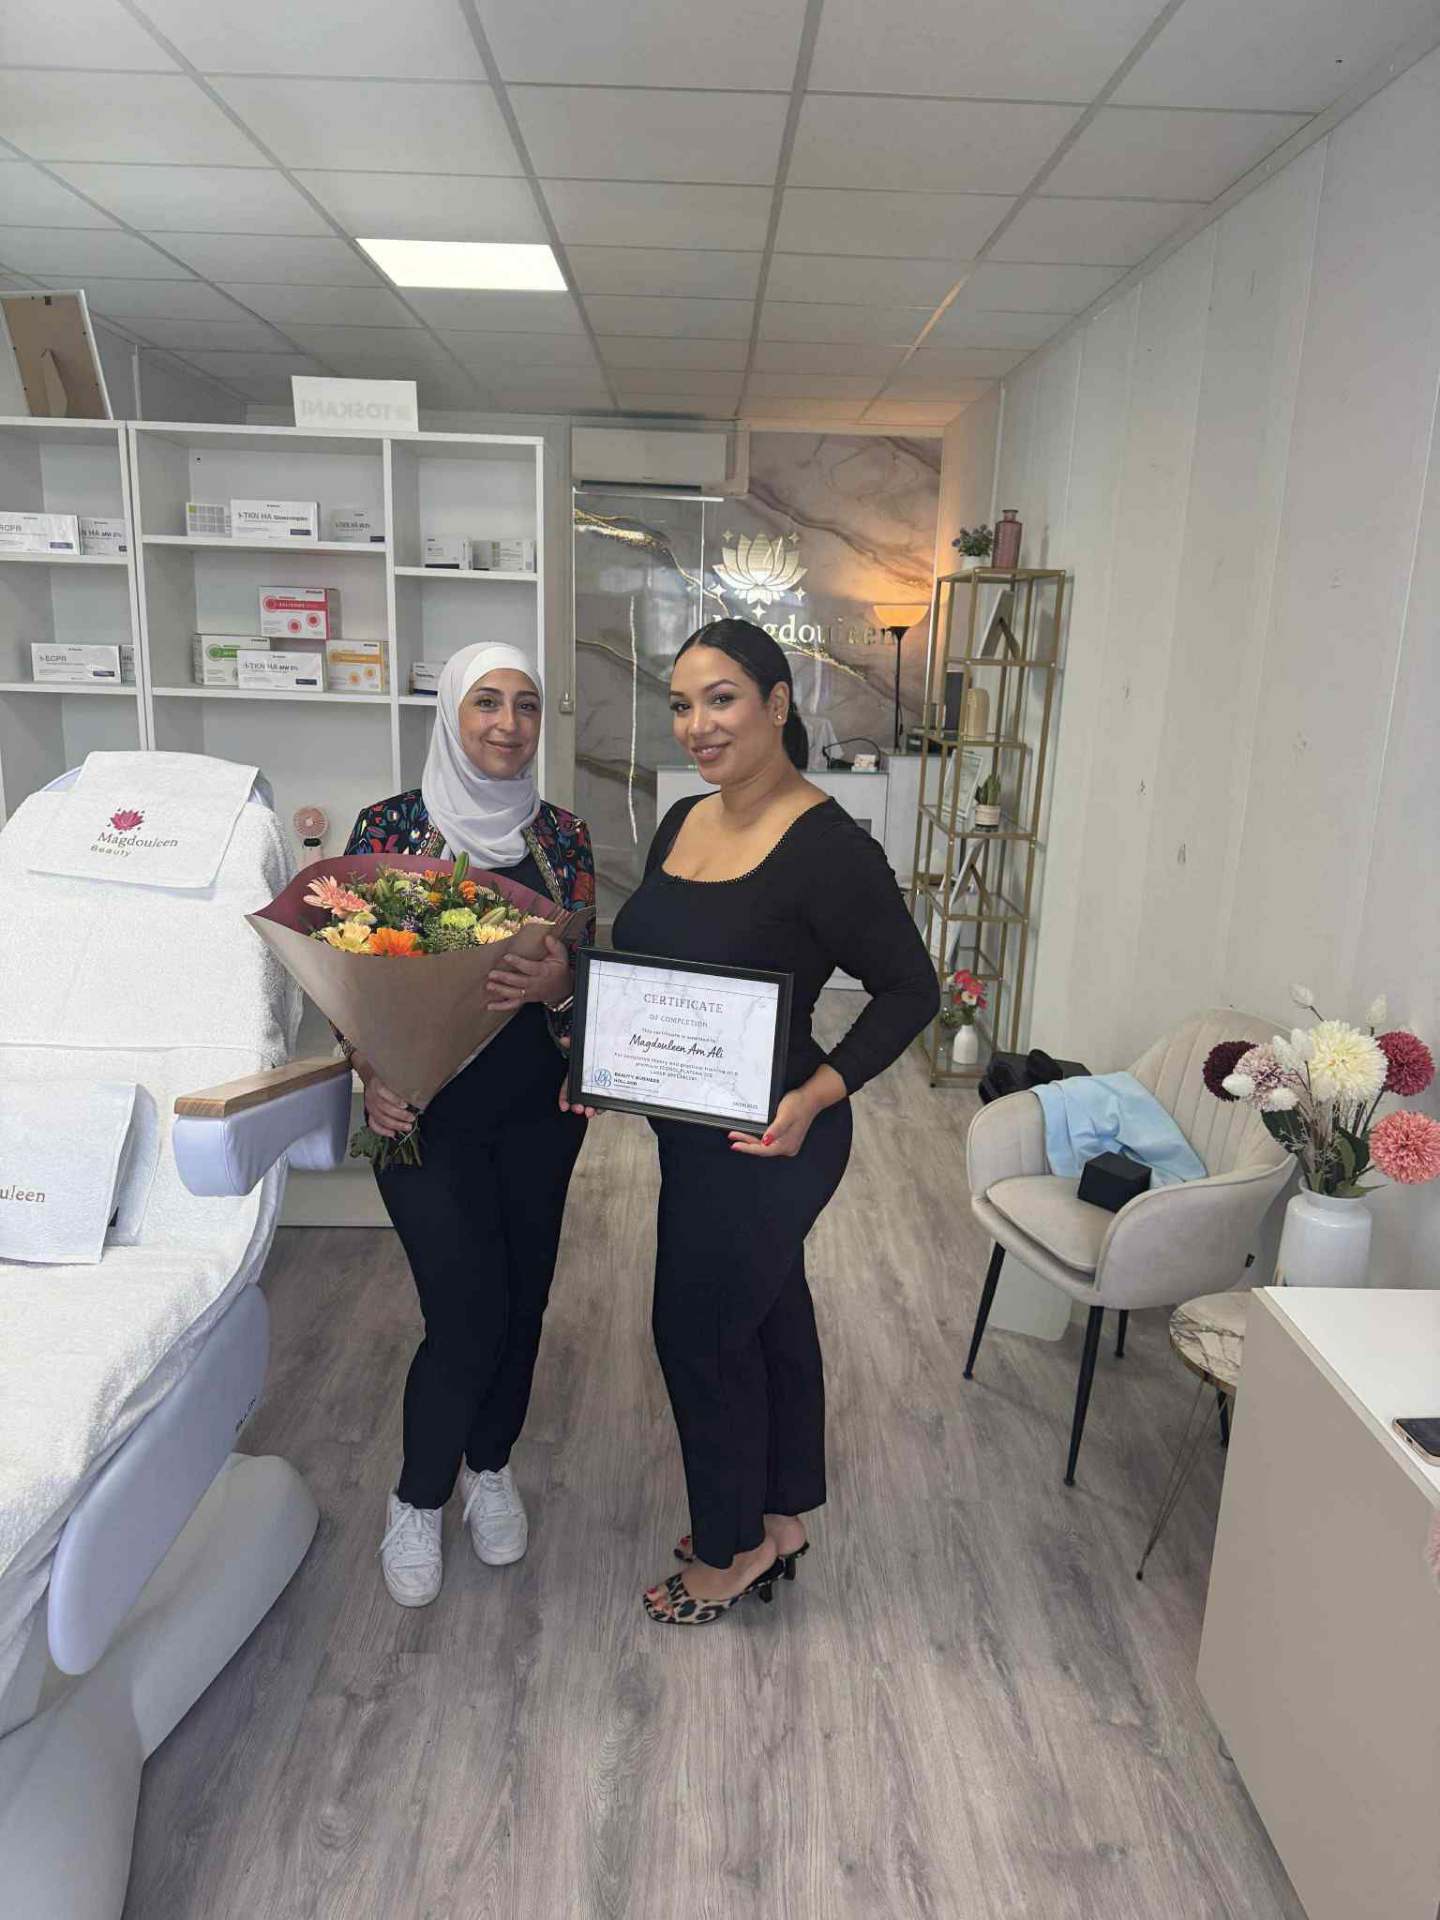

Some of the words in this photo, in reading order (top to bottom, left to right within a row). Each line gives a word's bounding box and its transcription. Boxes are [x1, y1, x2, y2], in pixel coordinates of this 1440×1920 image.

[97, 832, 179, 848] Magdouleen
[643, 993, 724, 1014] CERTIFICATE
[660, 1015, 708, 1028] COMPLETION
[629, 1034, 687, 1054] Magdouleen
[687, 1043, 706, 1057] Am
[705, 1046, 724, 1059] Ali
[0, 1184, 45, 1202] uleen
